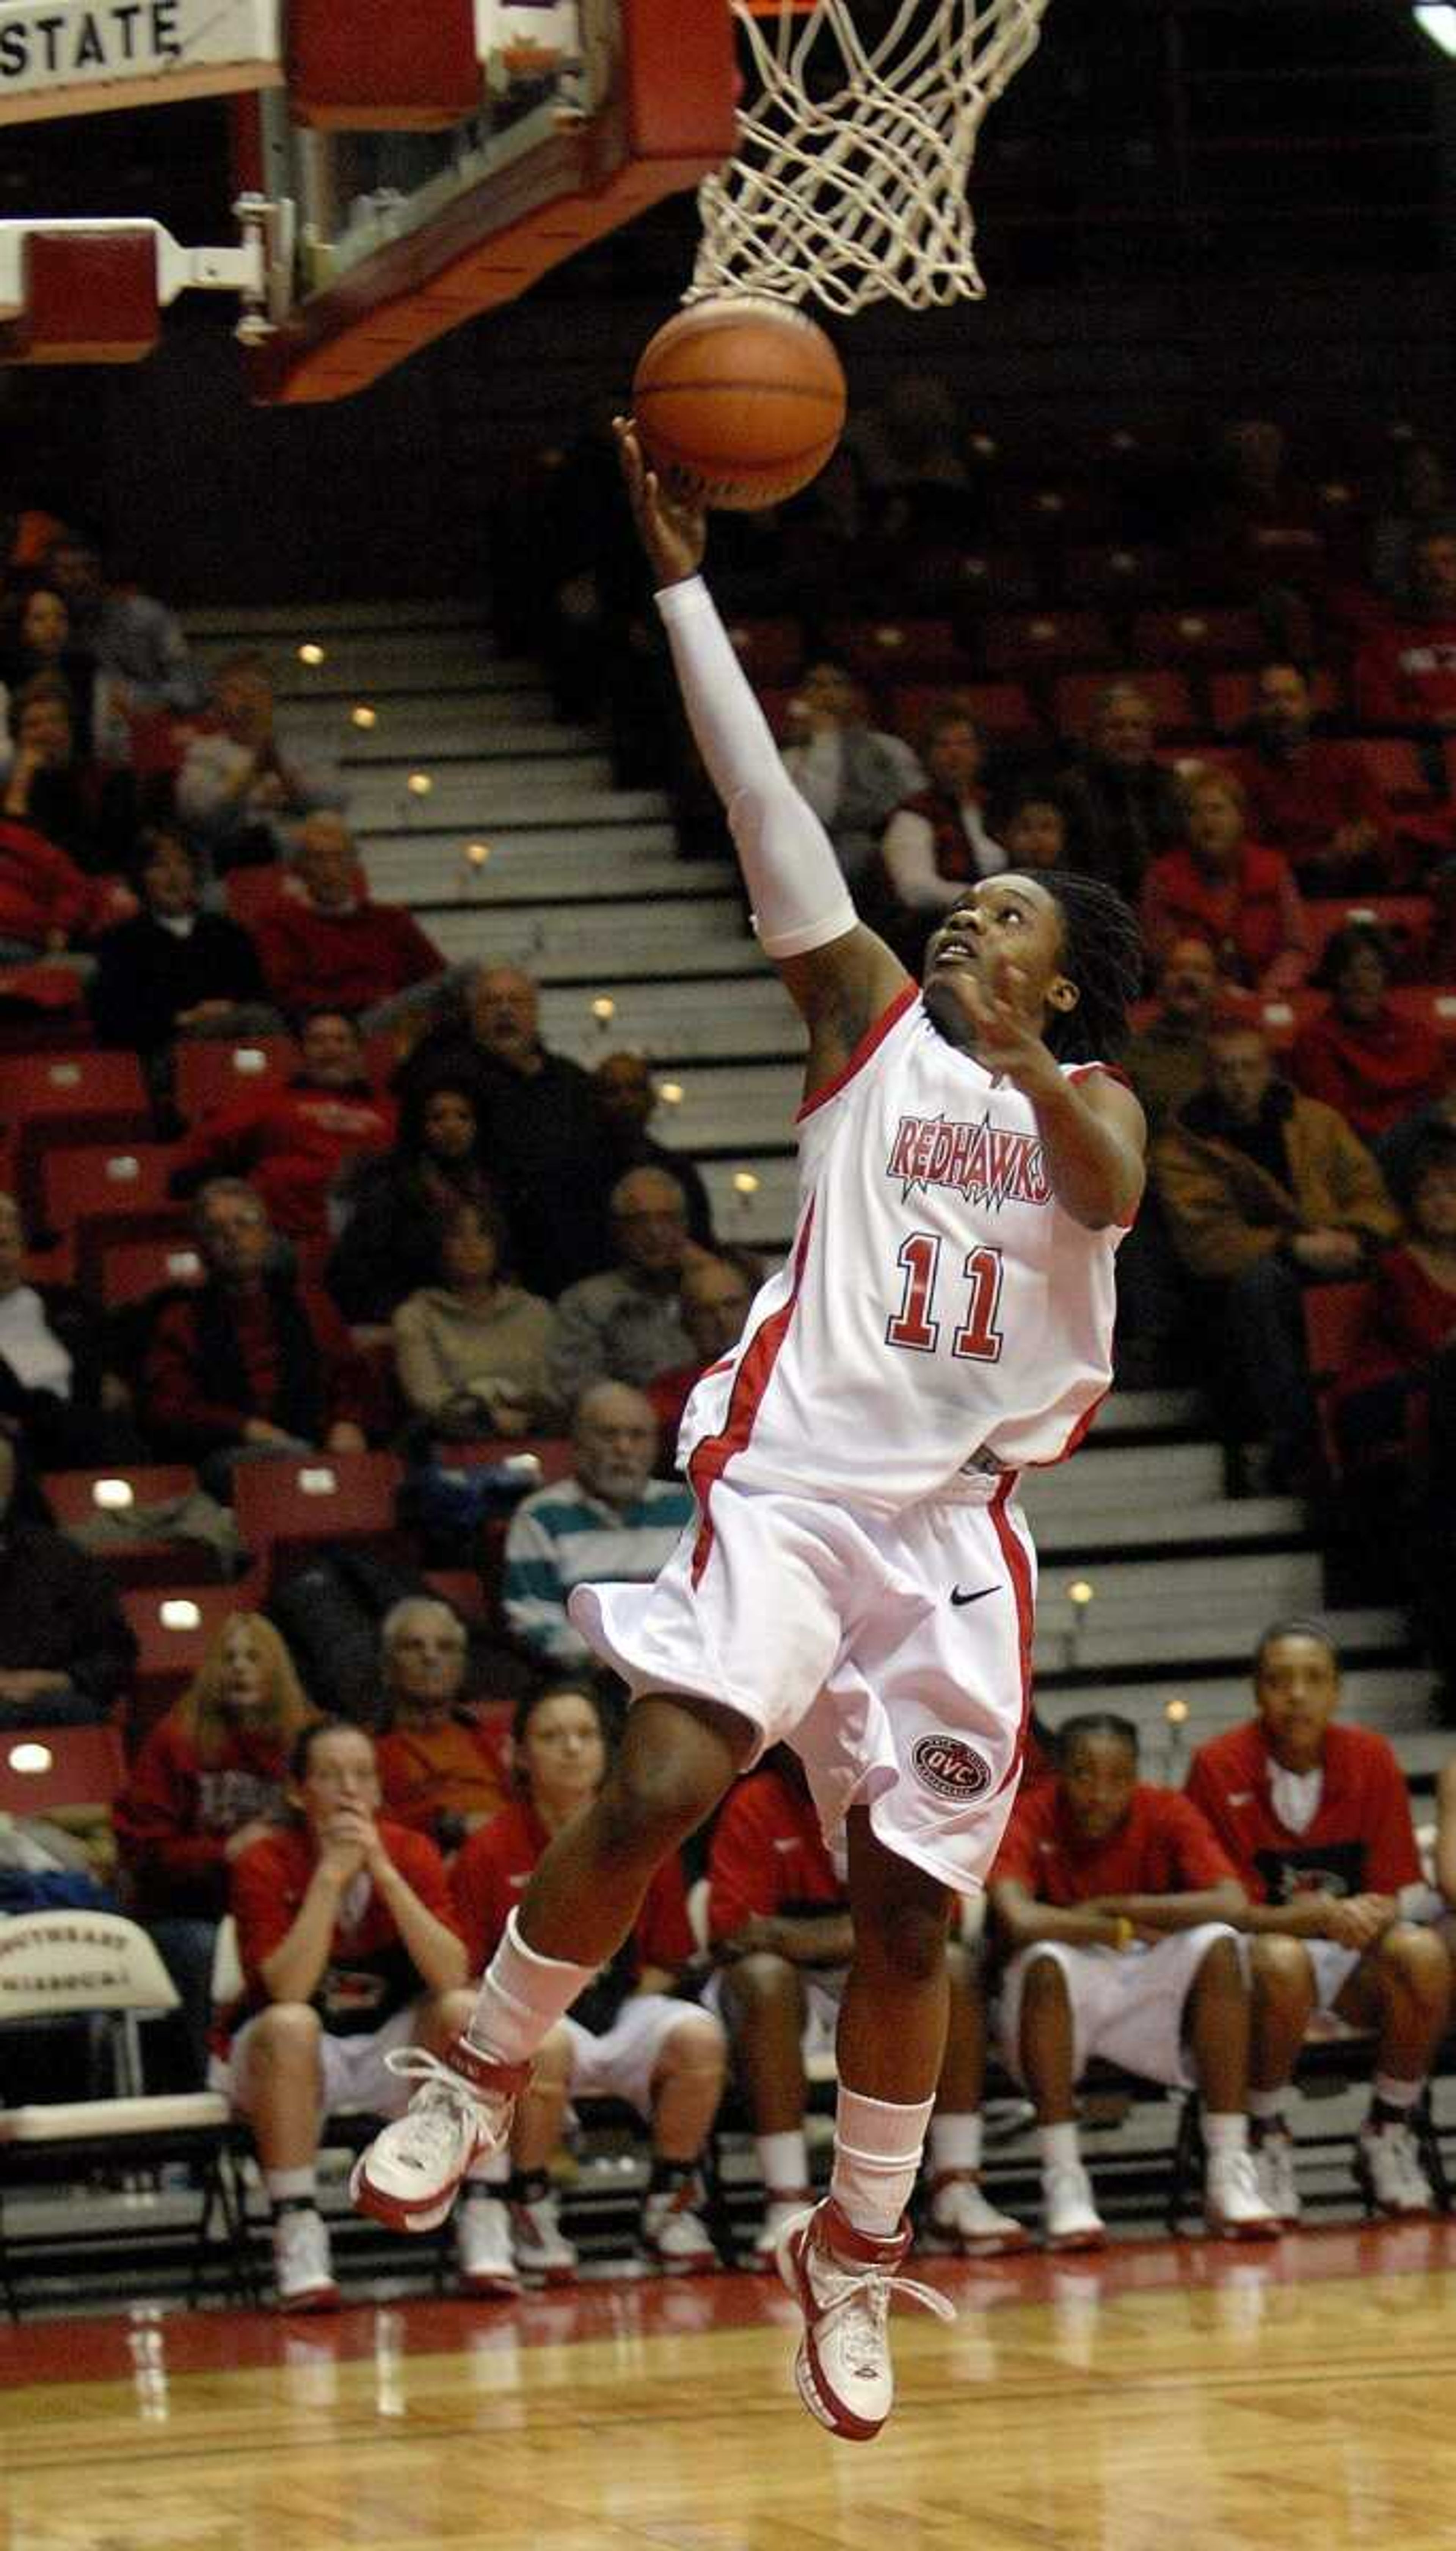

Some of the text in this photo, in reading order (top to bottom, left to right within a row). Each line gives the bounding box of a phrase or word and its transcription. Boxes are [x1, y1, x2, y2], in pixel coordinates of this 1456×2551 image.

[0, 0, 182, 76] STATE
[886, 1110, 1057, 1212] REDHAWKS
[885, 1231, 1003, 1363] 11
[928, 1750, 975, 1785] OVC
[0, 1925, 127, 1954] OUTHEAST
